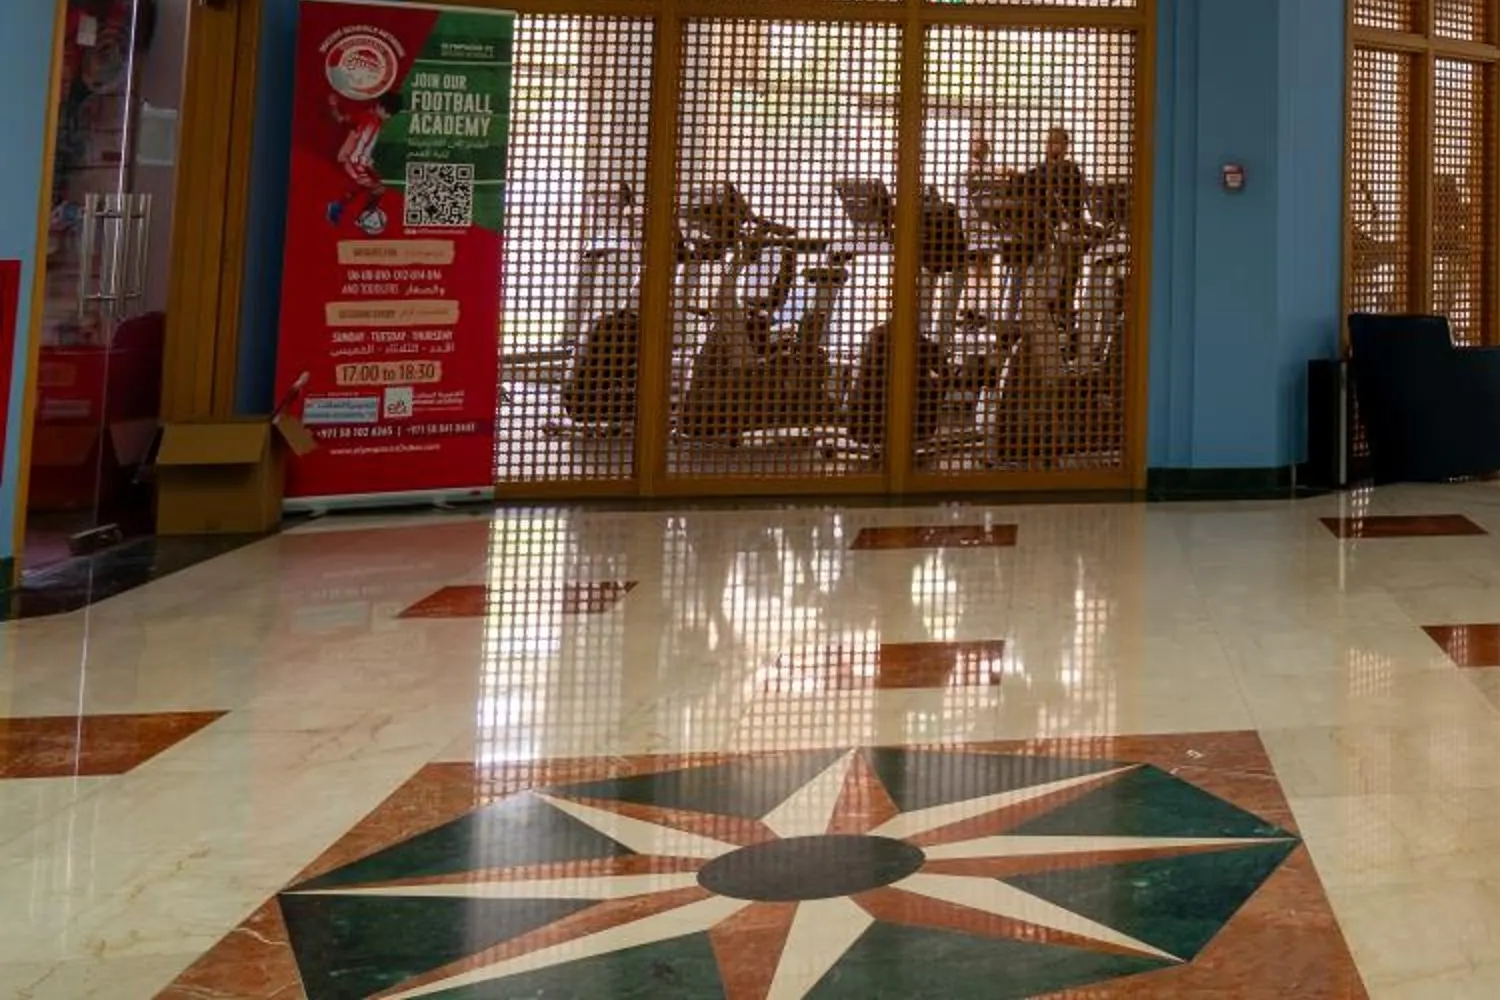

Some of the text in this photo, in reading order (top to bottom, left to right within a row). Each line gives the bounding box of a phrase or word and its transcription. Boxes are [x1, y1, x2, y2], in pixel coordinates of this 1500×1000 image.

[411, 72, 467, 90] JOIN OUR
[411, 90, 493, 114] FOOTBALL
[409, 113, 491, 137] ACADEMY
[371, 331, 406, 342] TUESDAY
[383, 367, 396, 381] to
